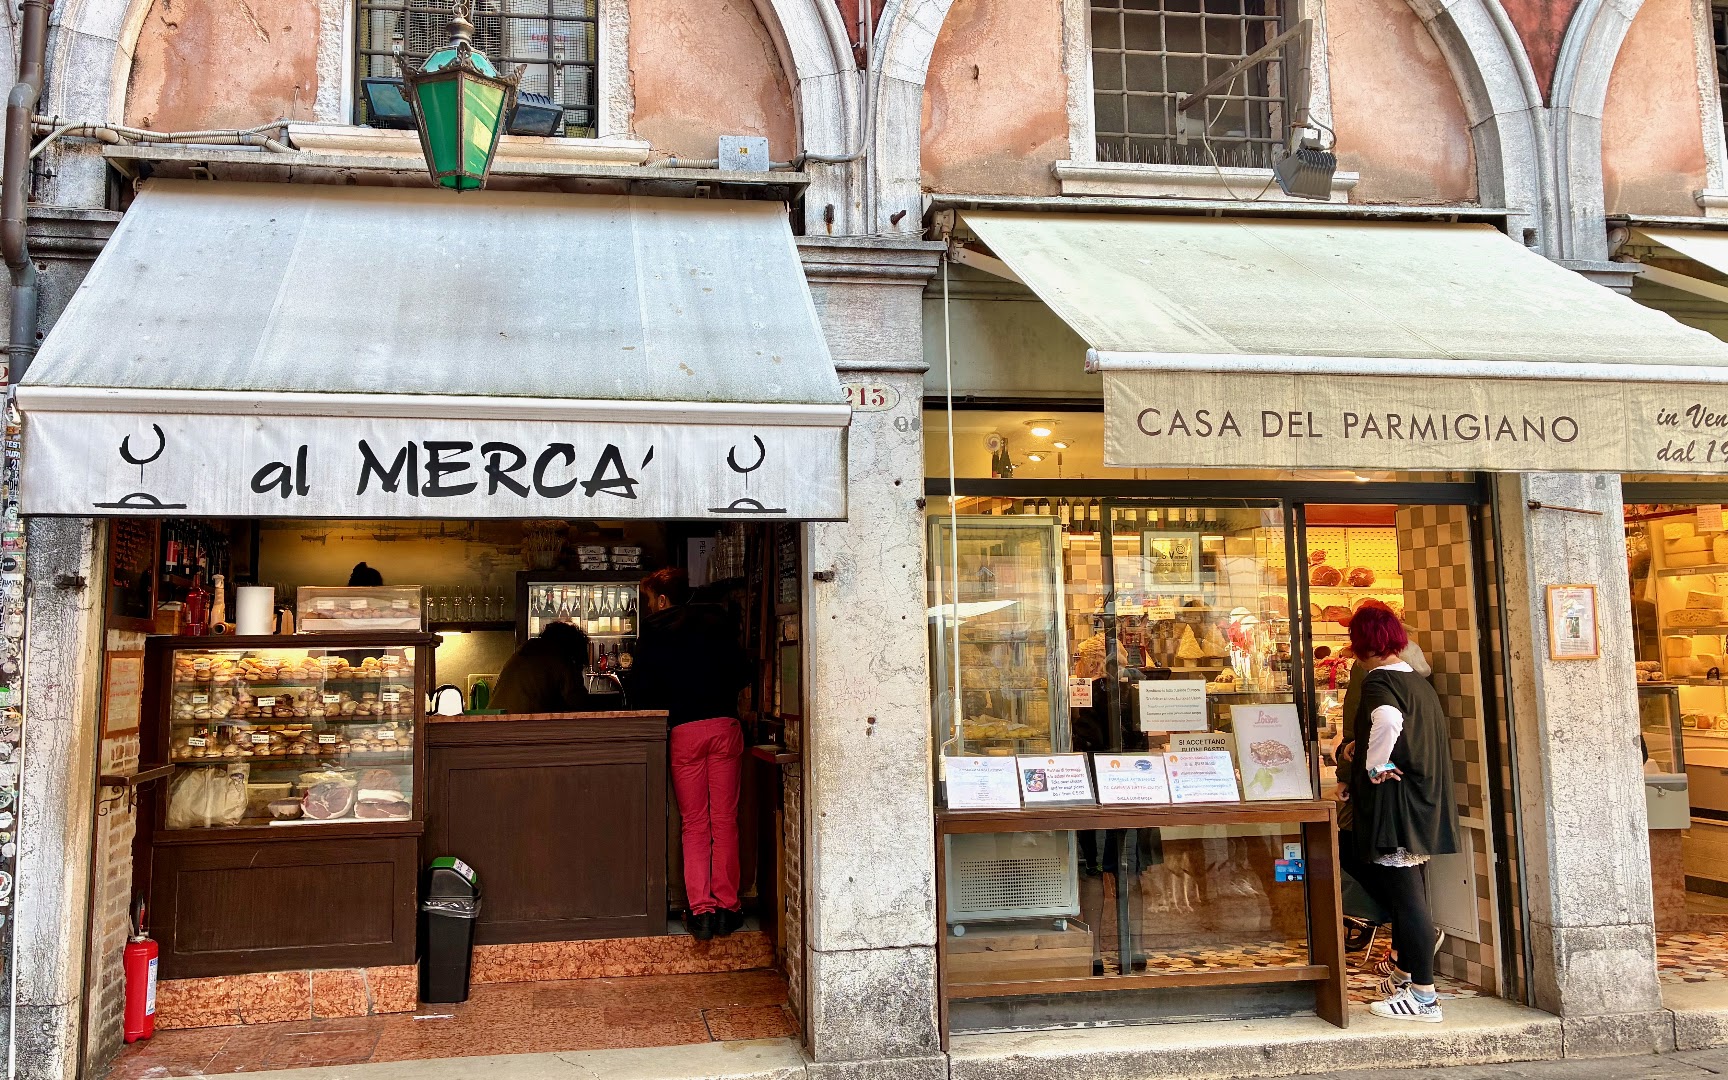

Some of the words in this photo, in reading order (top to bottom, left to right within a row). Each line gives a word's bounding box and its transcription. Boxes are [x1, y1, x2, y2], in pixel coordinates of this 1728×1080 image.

[1137, 407, 1242, 438] CASA
[1262, 410, 1323, 438] DEL
[1343, 411, 1579, 442] PARMIGIANO
[1656, 408, 1680, 426] in
[1656, 439, 1696, 463] dal
[250, 444, 311, 499] al
[356, 439, 654, 500] MERCA'
[1186, 738, 1226, 746] ACCETTANO
